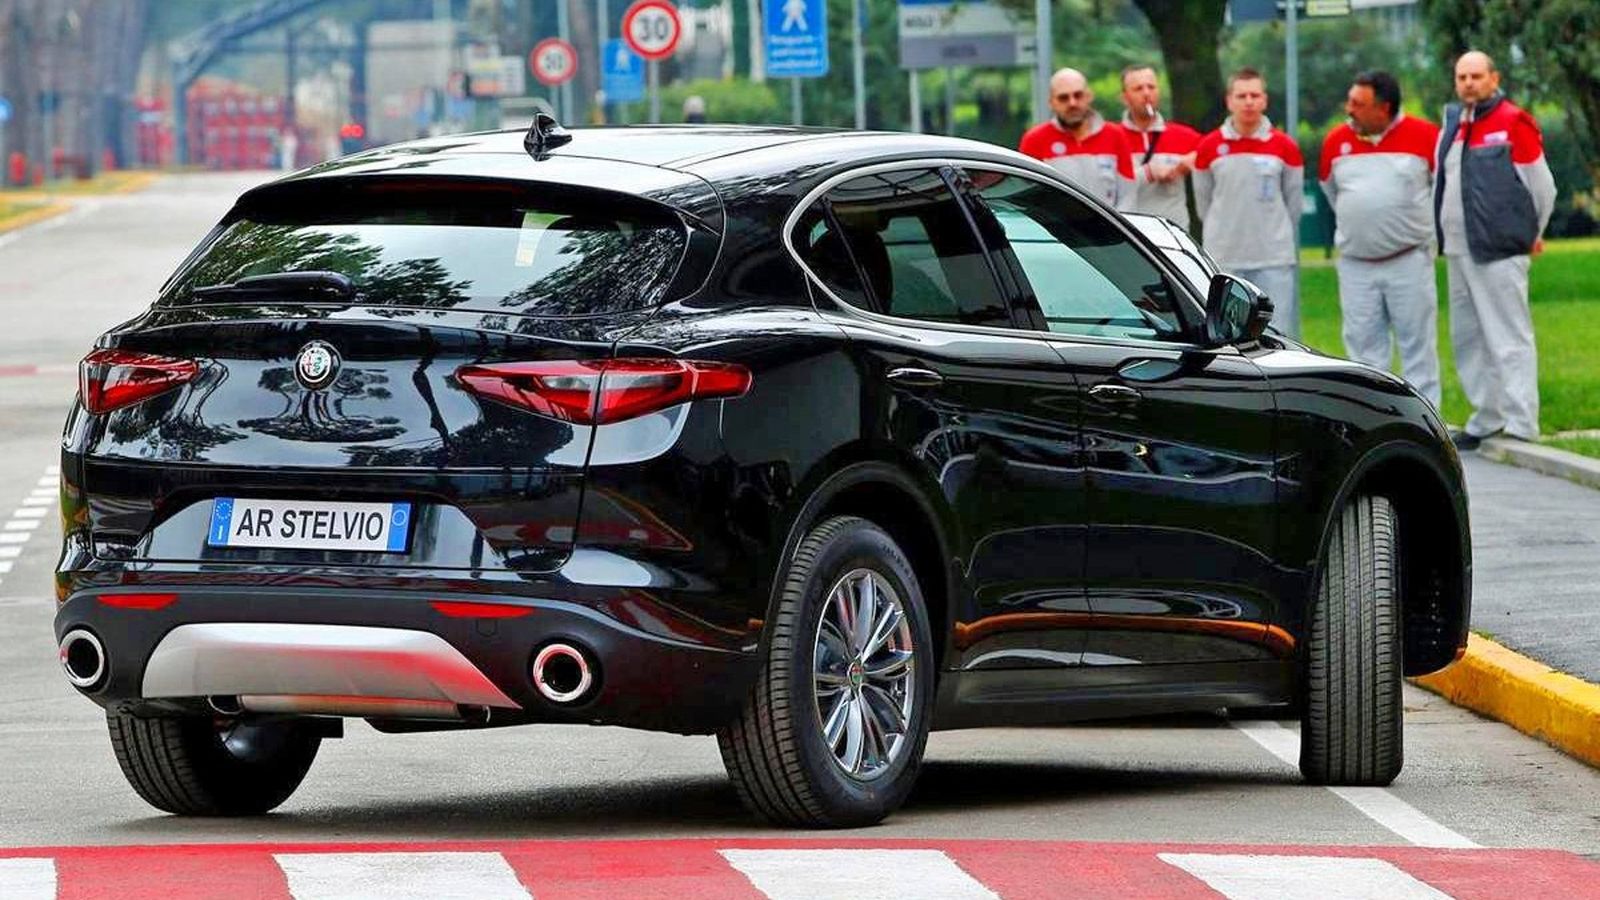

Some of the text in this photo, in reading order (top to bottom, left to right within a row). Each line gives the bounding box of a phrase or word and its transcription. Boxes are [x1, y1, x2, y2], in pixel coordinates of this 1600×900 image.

[637, 15, 669, 41] 30
[236, 508, 384, 541] AR STELVIO
